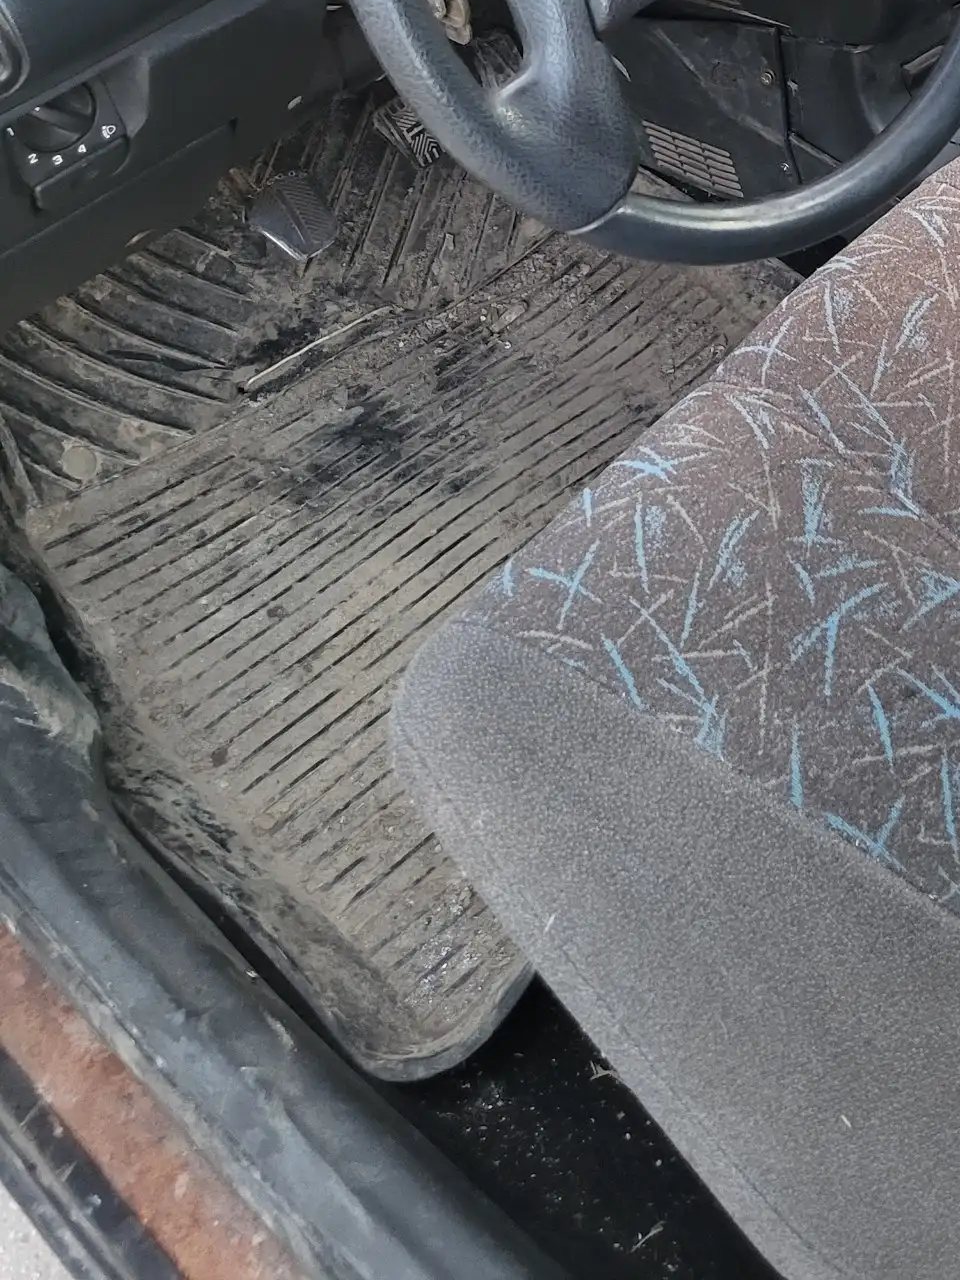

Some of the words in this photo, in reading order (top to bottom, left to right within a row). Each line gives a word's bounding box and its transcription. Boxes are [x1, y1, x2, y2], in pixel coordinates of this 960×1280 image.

[6, 127, 15, 136] 1
[77, 143, 87, 153] 4
[28, 153, 39, 164] 2
[52, 154, 63, 165] 3
